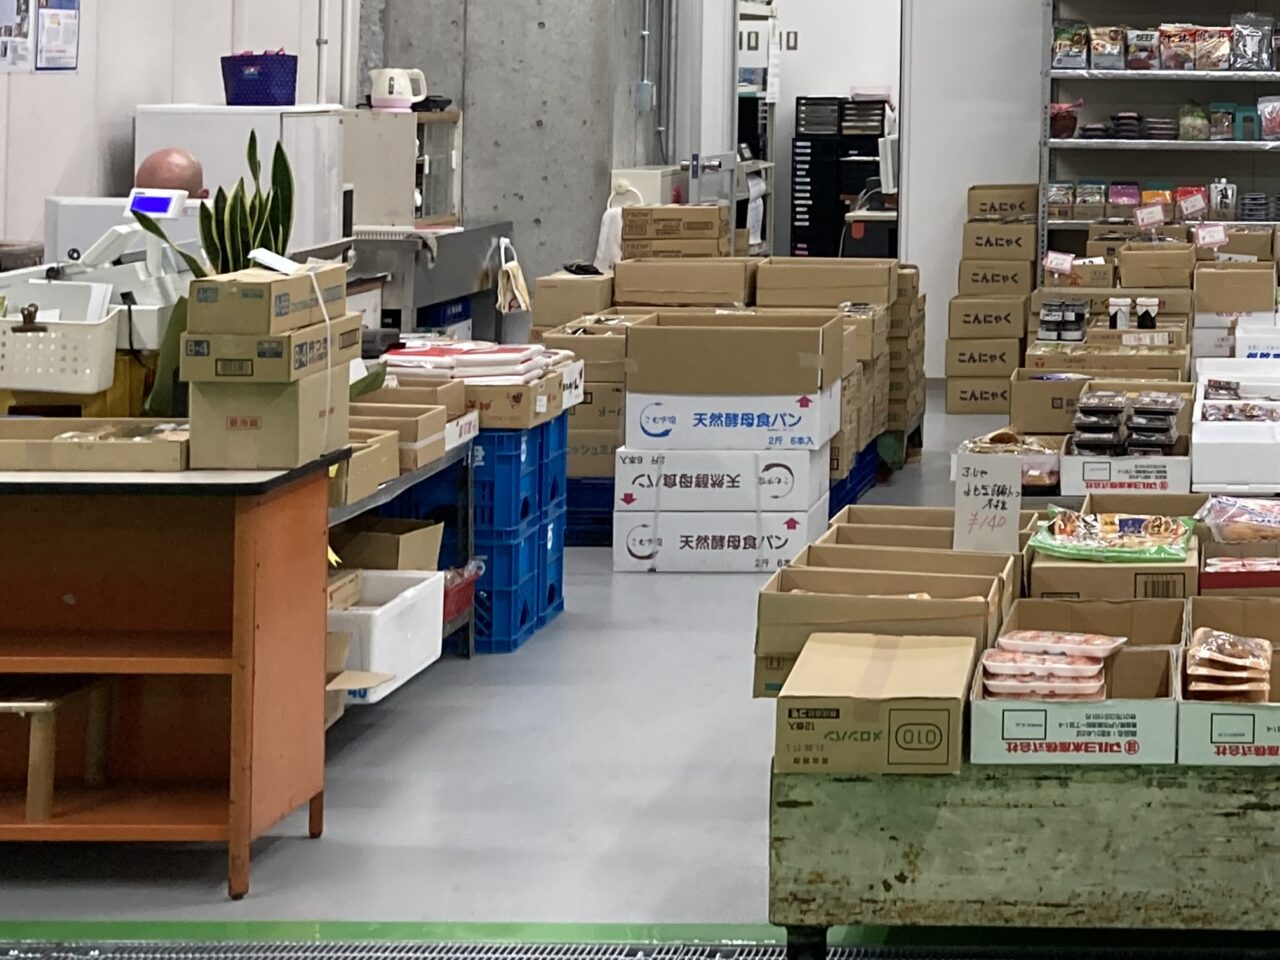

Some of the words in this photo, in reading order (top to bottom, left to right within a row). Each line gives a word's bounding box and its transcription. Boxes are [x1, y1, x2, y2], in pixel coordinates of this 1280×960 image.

[978, 201, 1026, 212] こんにゃく
[975, 236, 1022, 248] こんにゃく
[971, 273, 1018, 284] こんにゃく
[963, 313, 1011, 325] こんにゃく
[958, 352, 1006, 364] こんにゃく
[959, 390, 1008, 401] こんにゃく
[693, 412, 803, 428] 天然酵母食パン
[631, 473, 741, 489] 天然酵母食パン
[679, 534, 790, 550] 天然酵母食パン
[824, 730, 884, 742] メロンパン
[903, 729, 936, 744] 010
